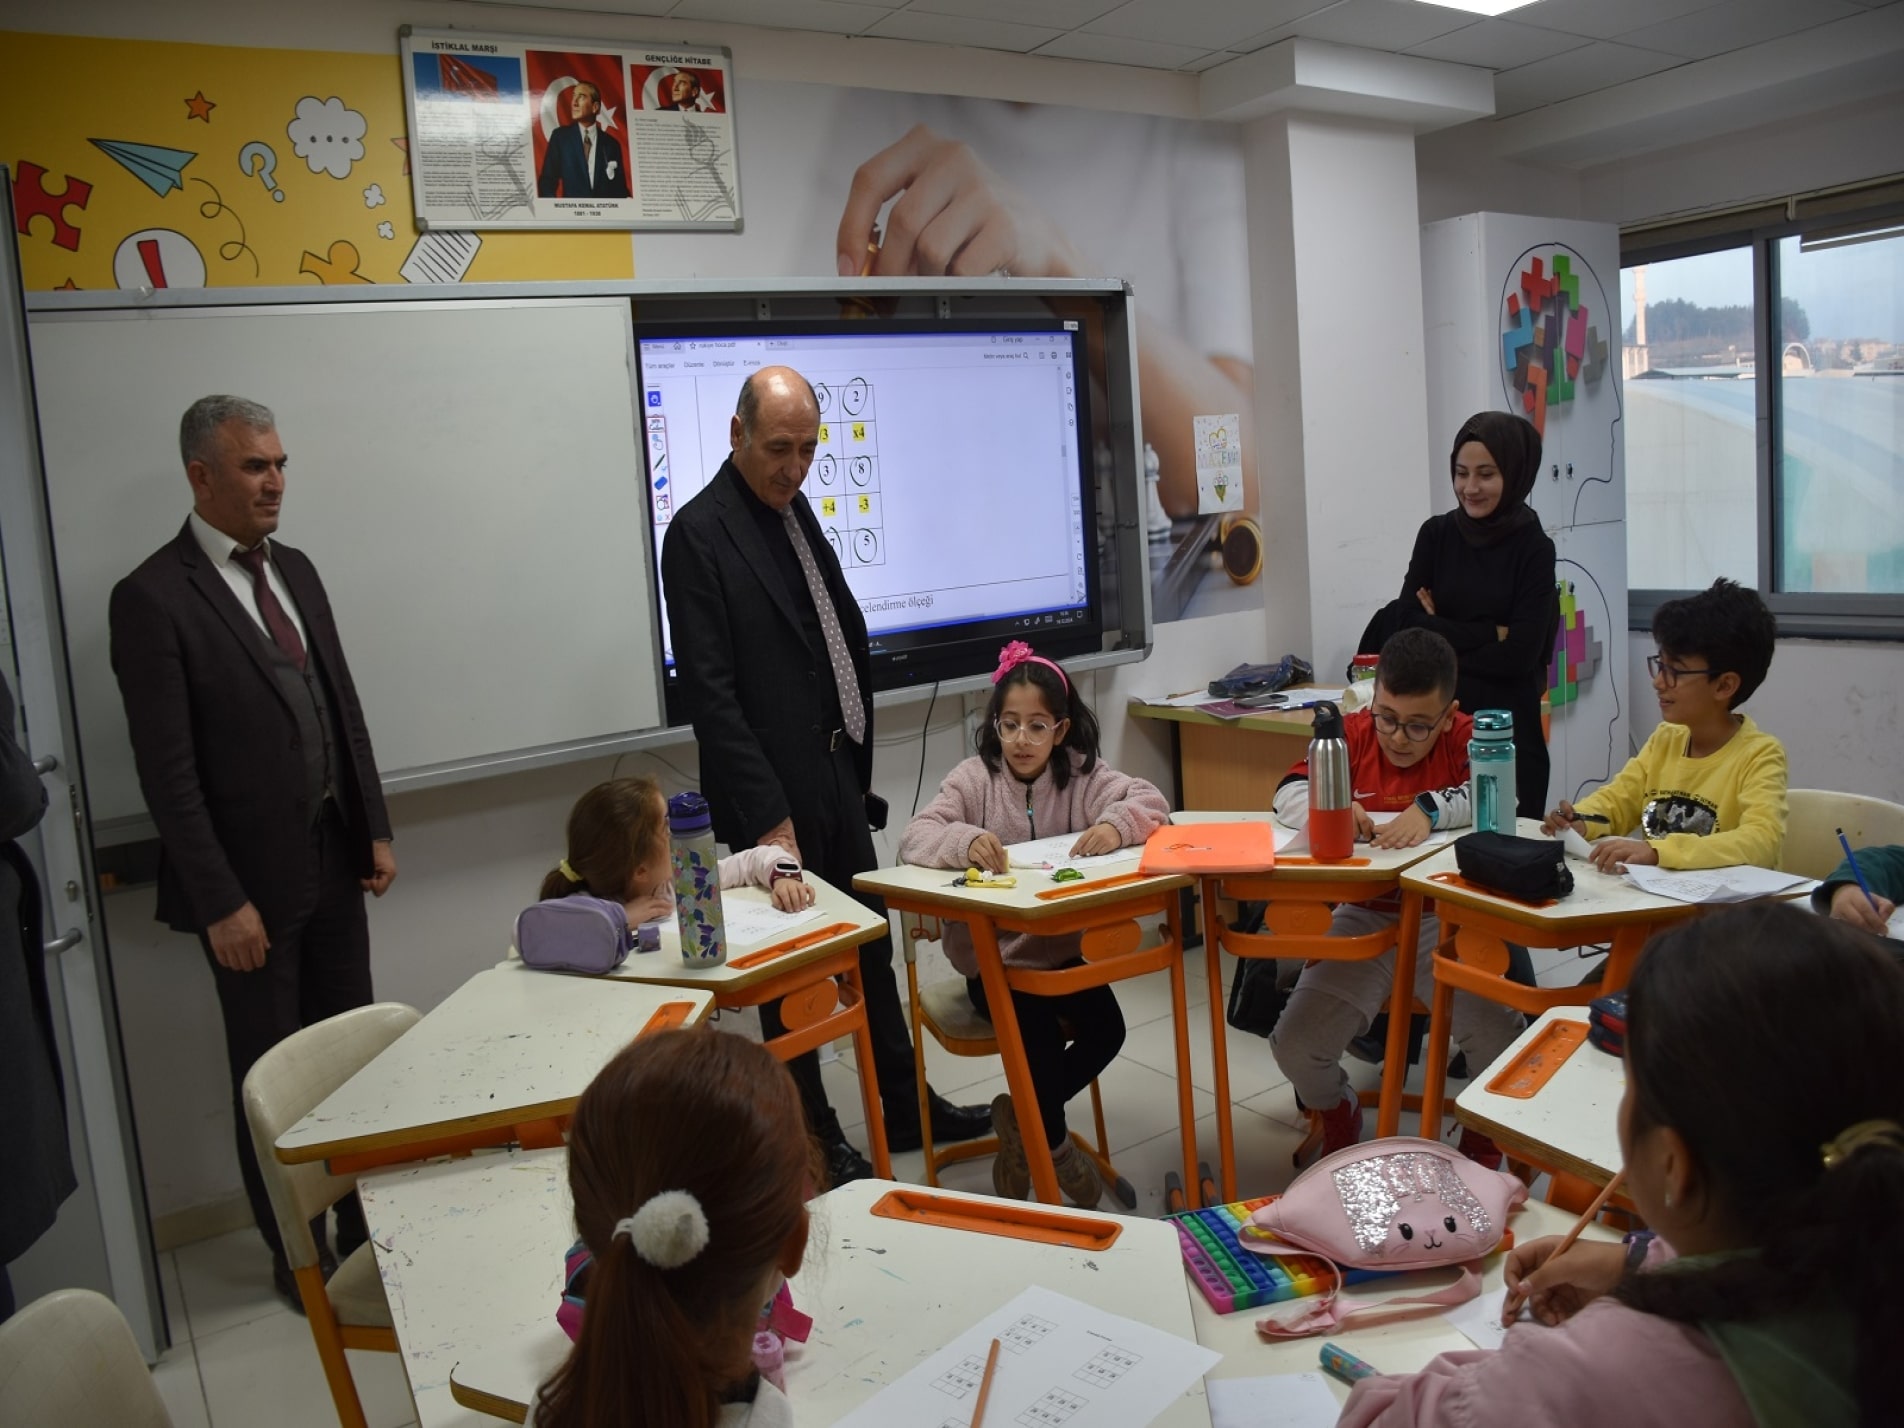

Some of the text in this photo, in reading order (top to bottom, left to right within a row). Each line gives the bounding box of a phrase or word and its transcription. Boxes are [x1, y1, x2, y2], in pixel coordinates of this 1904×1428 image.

[431, 40, 498, 54] İSTİKLAL MARŞI
[645, 54, 711, 65] GENÇLİĞE HİTABE
[854, 391, 860, 402] 2
[853, 426, 865, 439] x4
[824, 463, 865, 477] 3 8
[823, 498, 869, 513] +4 -3
[863, 534, 870, 546] 5
[908, 594, 934, 609] ölçeği
